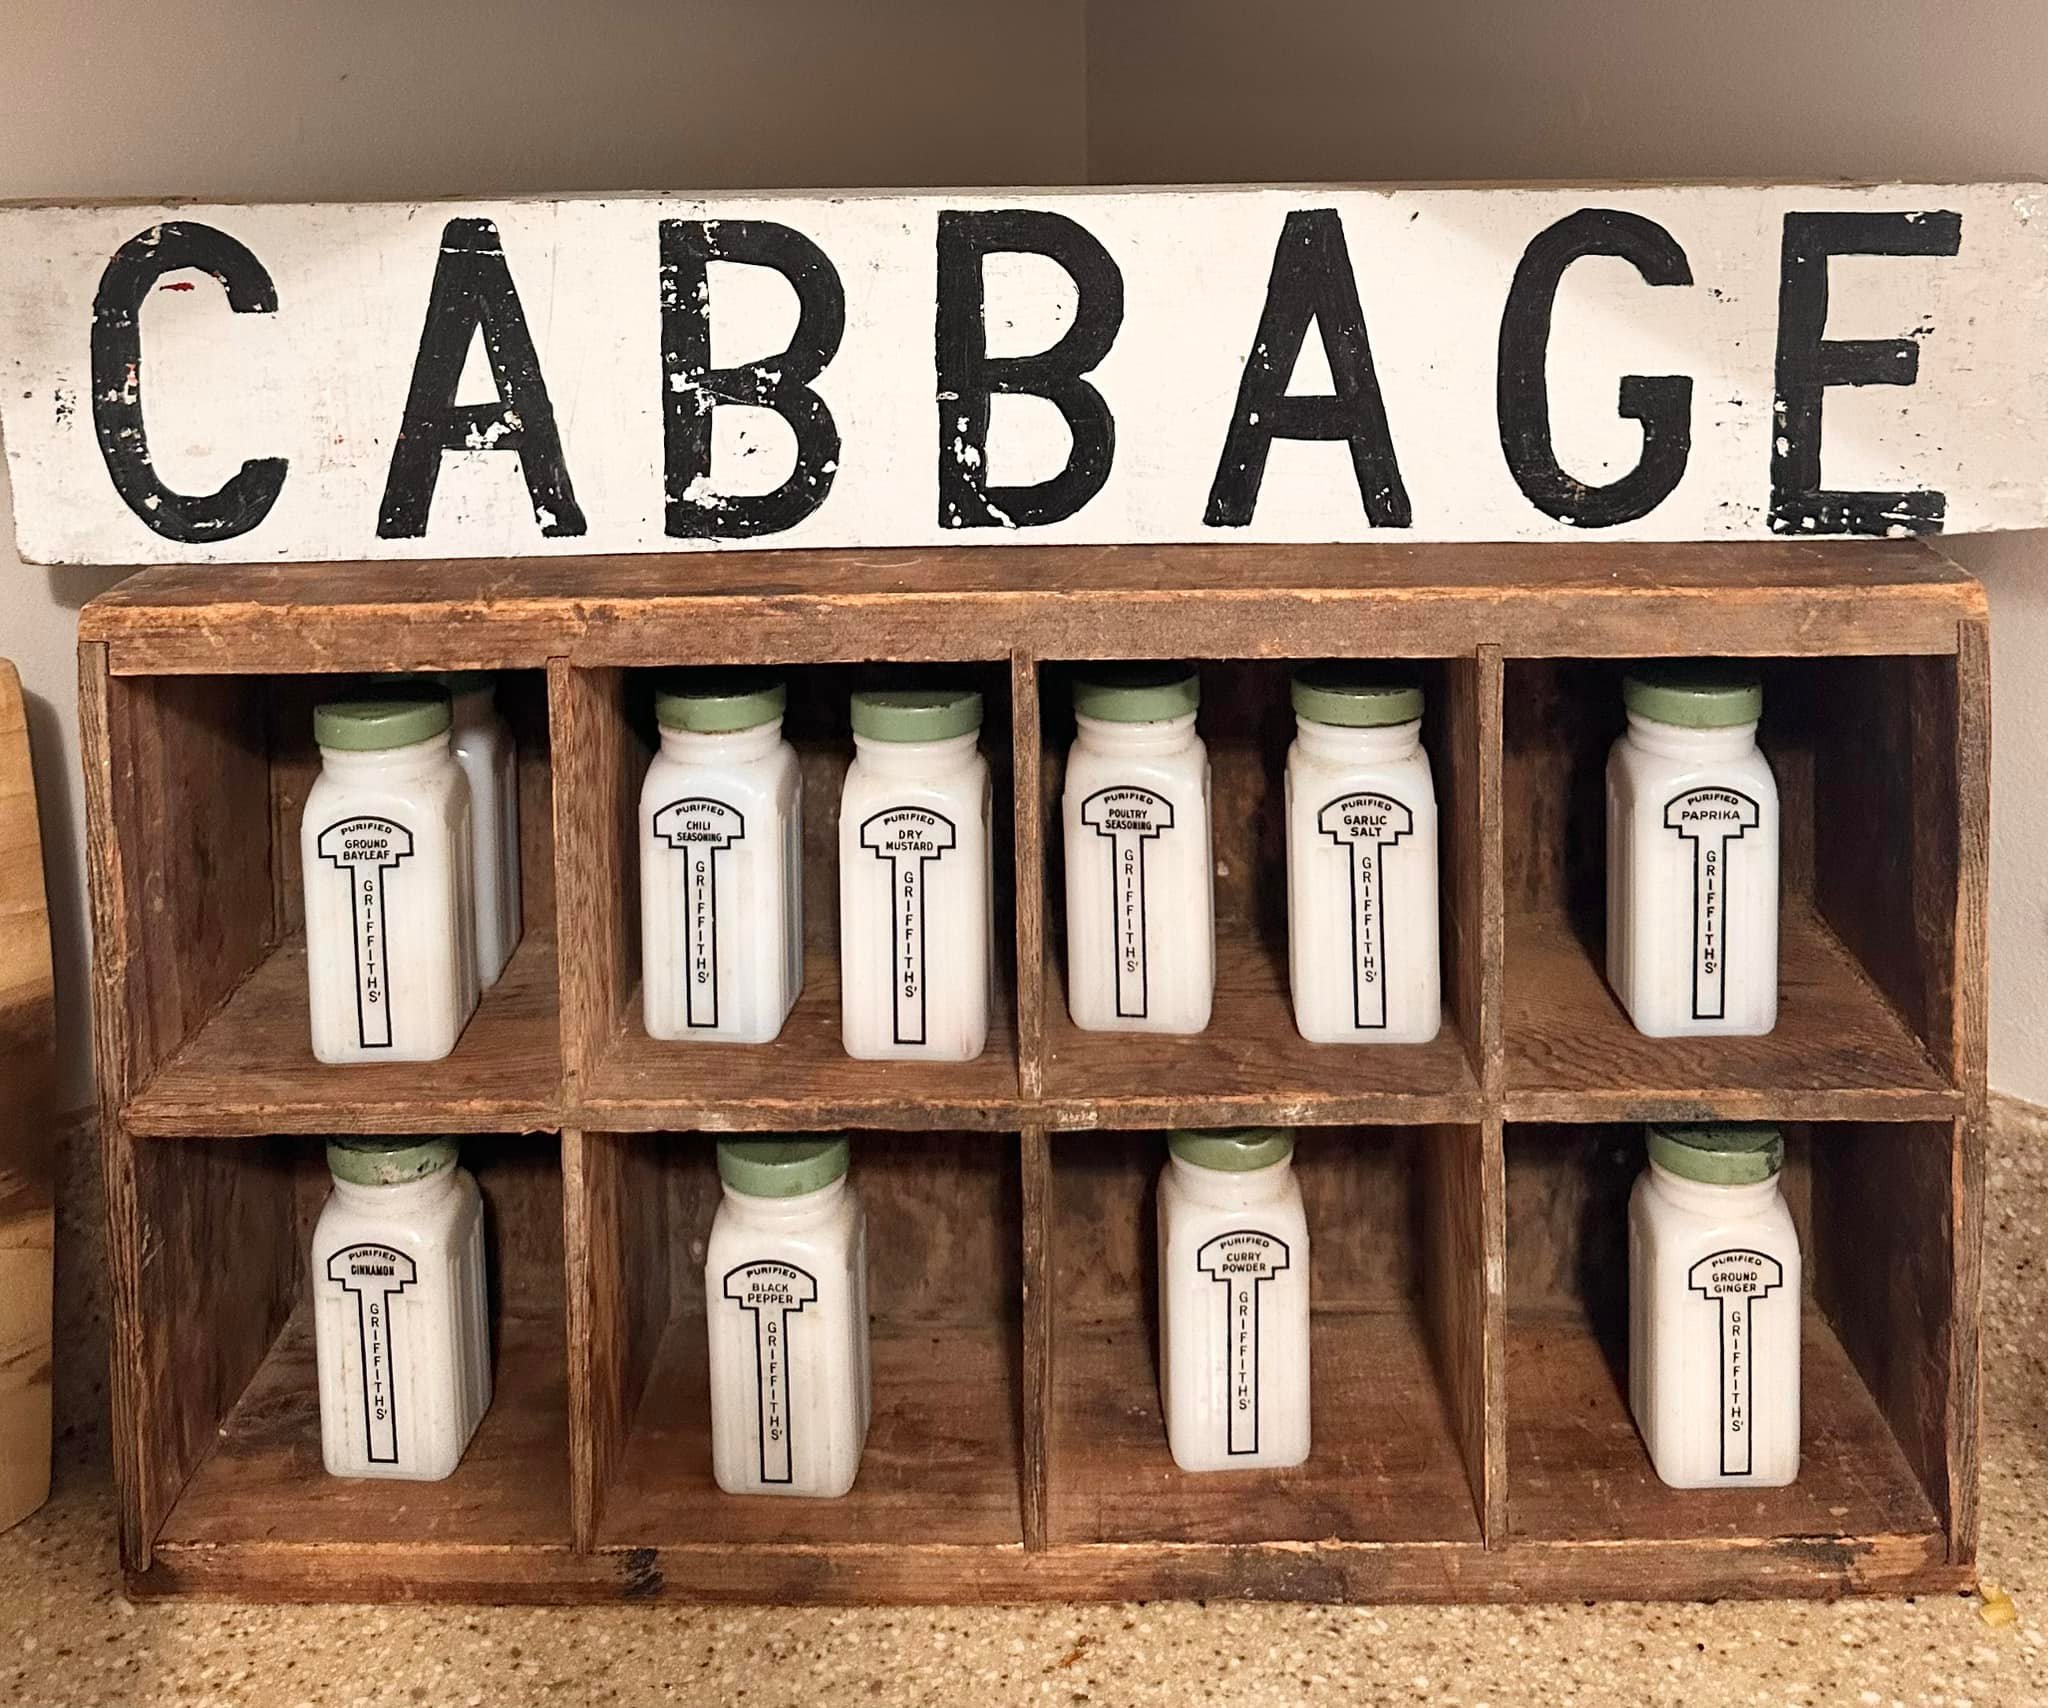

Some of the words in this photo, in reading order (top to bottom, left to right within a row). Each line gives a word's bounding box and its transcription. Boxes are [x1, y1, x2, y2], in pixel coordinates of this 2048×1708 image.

[91, 208, 1962, 543] CABBAGE
[1104, 793, 1153, 805] PURIFIED
[1687, 793, 1738, 805] PURIFIED
[675, 804, 725, 816] PURIFIED
[1341, 799, 1392, 812] PURIFIED
[884, 813, 935, 825] PURIFIED
[1109, 808, 1147, 819] POULTRY
[1682, 811, 1740, 820] PAPRIKA
[686, 821, 711, 830] CHILI
[1105, 819, 1152, 830] SEASONING
[1344, 815, 1387, 825] GARLIC
[340, 822, 392, 835] PURIFIED
[1350, 827, 1382, 836] SALT
[677, 832, 722, 842] SEASONING
[899, 830, 923, 839] DRY
[345, 839, 388, 849] GROUND
[886, 842, 933, 850] MUSTARD
[343, 850, 390, 860] BAYLEAF
[1220, 1237, 1269, 1249] PURIFIED
[349, 1250, 396, 1262] PURIFIED
[1227, 1252, 1261, 1262] CURRY
[1712, 1255, 1762, 1267] PURIFIED
[351, 1264, 394, 1276] CINNAMON
[747, 1267, 796, 1279] PURIFIED
[1222, 1263, 1266, 1272] POWDER
[1712, 1272, 1757, 1282] GROUND
[752, 1283, 788, 1292] BLACK
[1714, 1283, 1756, 1292] GINGER
[748, 1293, 793, 1304] PEPPER
